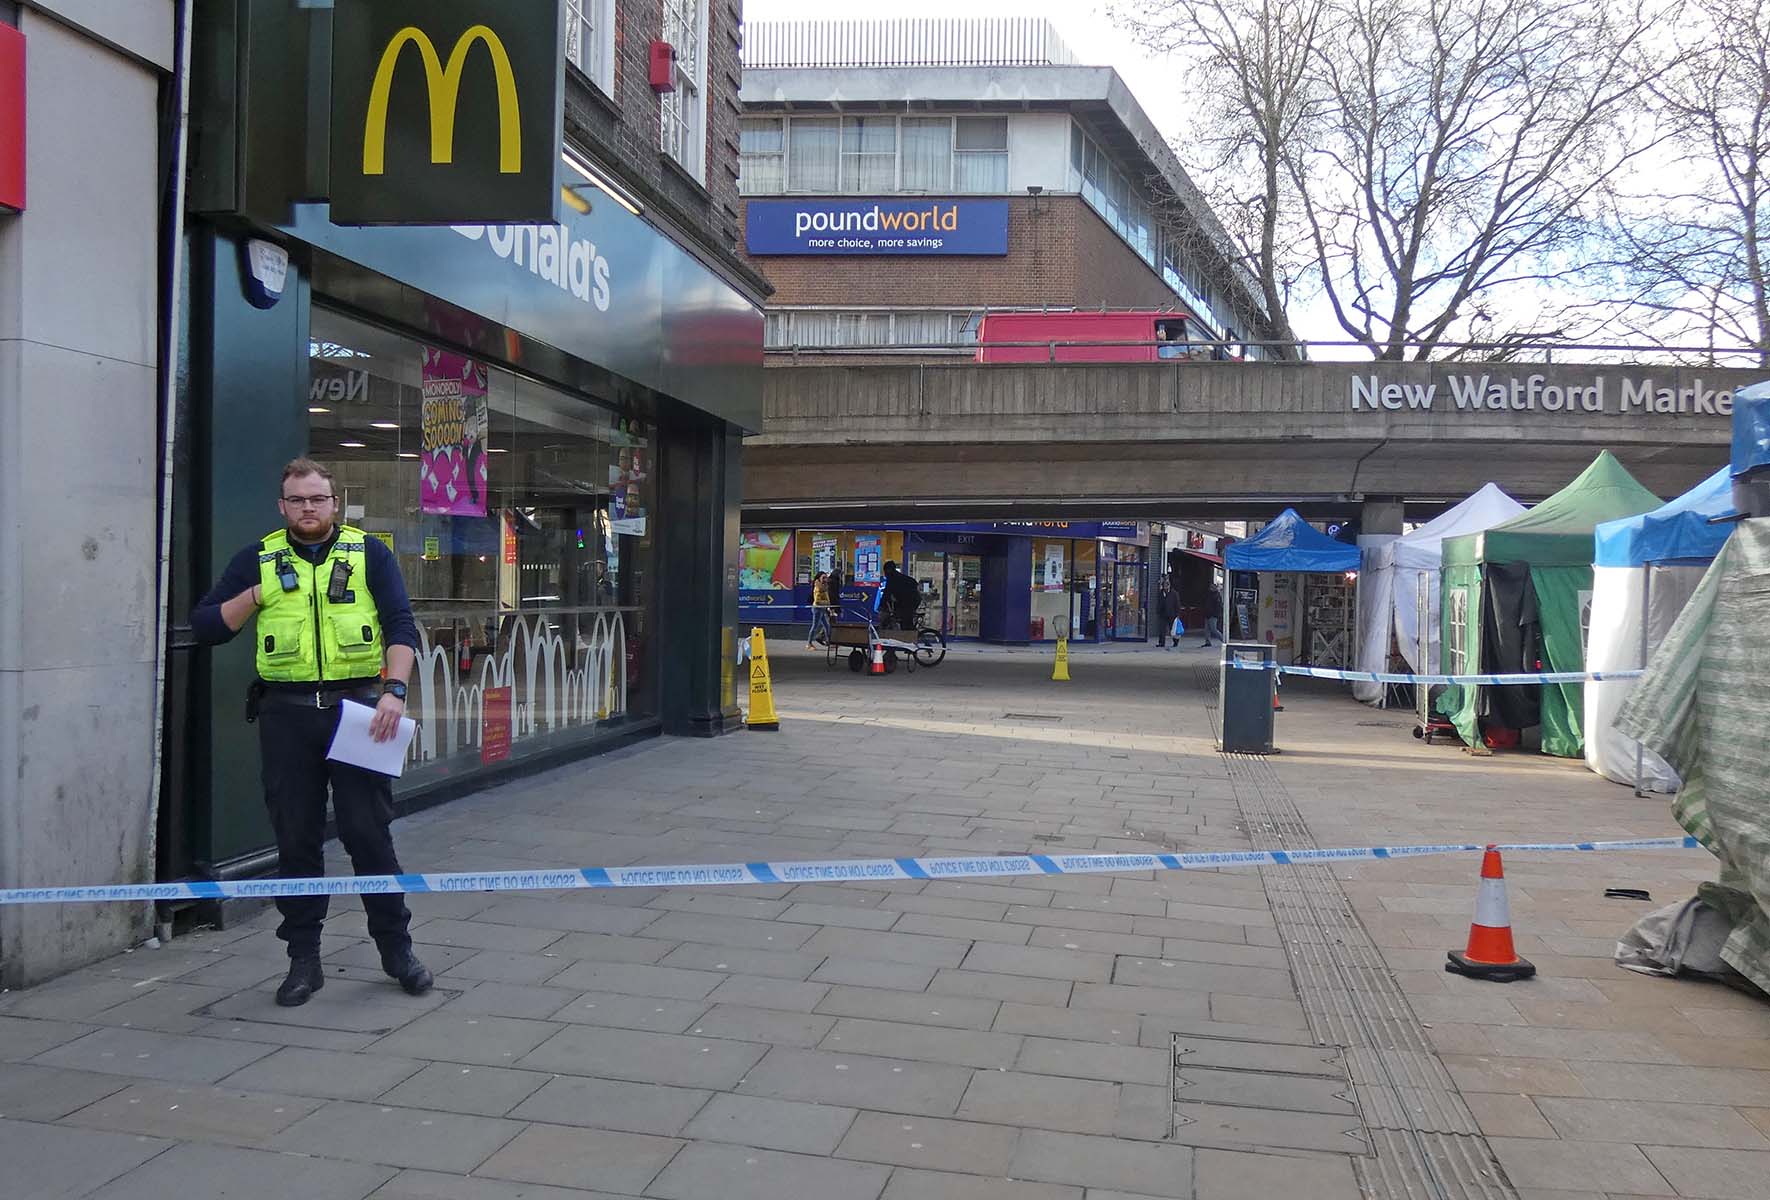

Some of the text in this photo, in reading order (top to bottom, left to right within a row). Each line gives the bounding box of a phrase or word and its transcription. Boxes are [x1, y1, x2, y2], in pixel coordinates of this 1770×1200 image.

[796, 206, 957, 236] poundworld
[809, 235, 943, 248] more choice, more savings
[425, 382, 461, 396] MONOPOLY
[1351, 374, 1742, 415] New Watford Marke
[424, 400, 465, 426] COMING
[958, 535, 976, 543] EXIT
